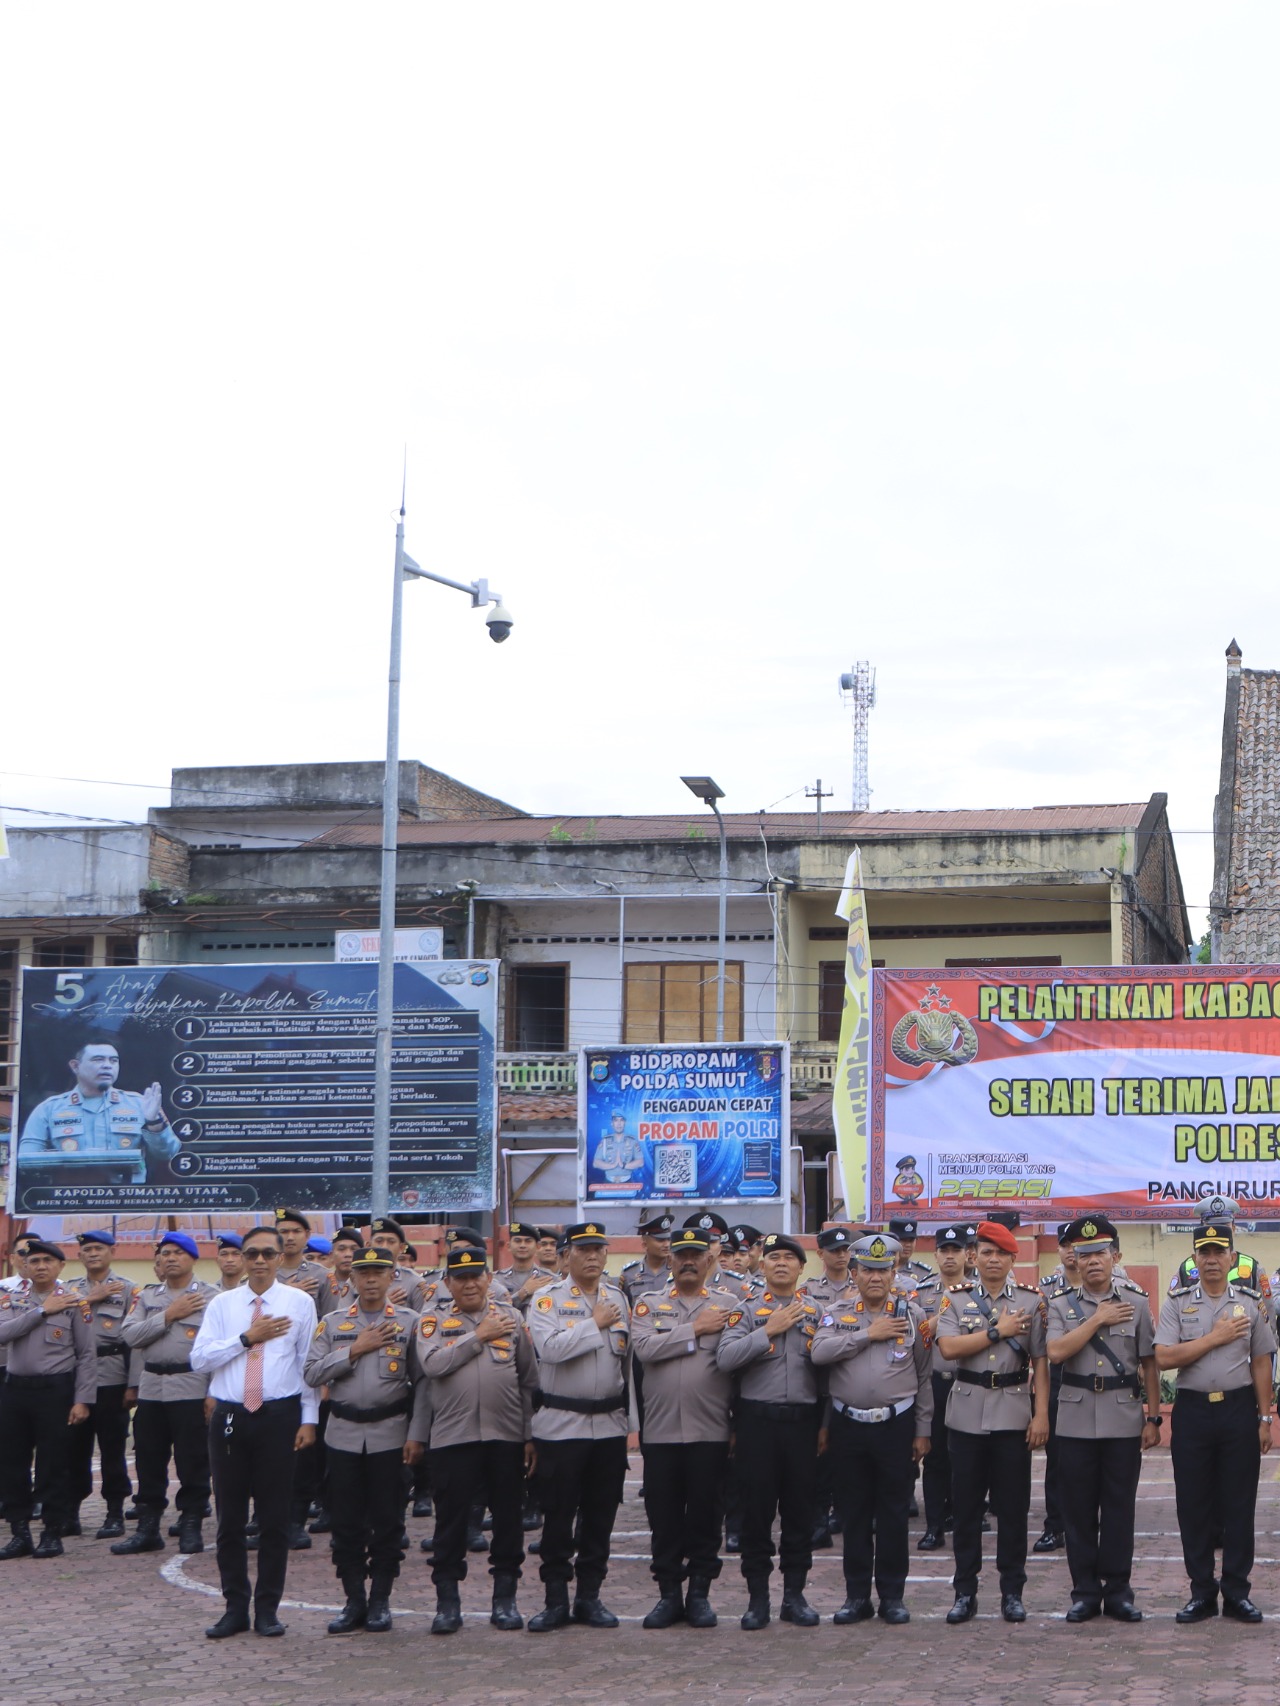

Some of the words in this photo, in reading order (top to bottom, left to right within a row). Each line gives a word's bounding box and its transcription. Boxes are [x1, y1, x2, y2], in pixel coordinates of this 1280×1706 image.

[54, 973, 85, 1004] 5
[106, 974, 157, 997] Arah
[105, 993, 208, 1018] Kebijakan
[215, 991, 299, 1012] Kapolda
[307, 989, 380, 1010] Sumut
[978, 983, 1174, 1021] PELANTIKAN
[185, 1022, 193, 1034] 1
[264, 1020, 289, 1028] setiap
[292, 1020, 315, 1028] tugas
[182, 1057, 195, 1069] 2
[630, 1052, 737, 1070] BIDPROPAM
[620, 1073, 680, 1090] POLDA
[685, 1072, 748, 1089] SUMUT
[181, 1090, 193, 1103] 3
[988, 1078, 1095, 1116] SERAH
[1102, 1076, 1227, 1115] TERIMA
[643, 1099, 727, 1113] PENGADUAN
[730, 1098, 772, 1112] CEPAT
[180, 1123, 193, 1135] 4
[639, 1121, 718, 1140] PROPAM
[725, 1120, 777, 1138] POLRI
[180, 1157, 192, 1169] 5
[938, 1153, 1029, 1164] TRANSFORMASI
[938, 1165, 985, 1175] MENUJU
[988, 1164, 1022, 1175] POLRI
[1024, 1164, 1056, 1174] YANG
[54, 1189, 114, 1197] KAPOLDA
[119, 1188, 180, 1196] SUMATRA
[185, 1187, 228, 1195] UTARA
[938, 1179, 1053, 1198] PRESISI
